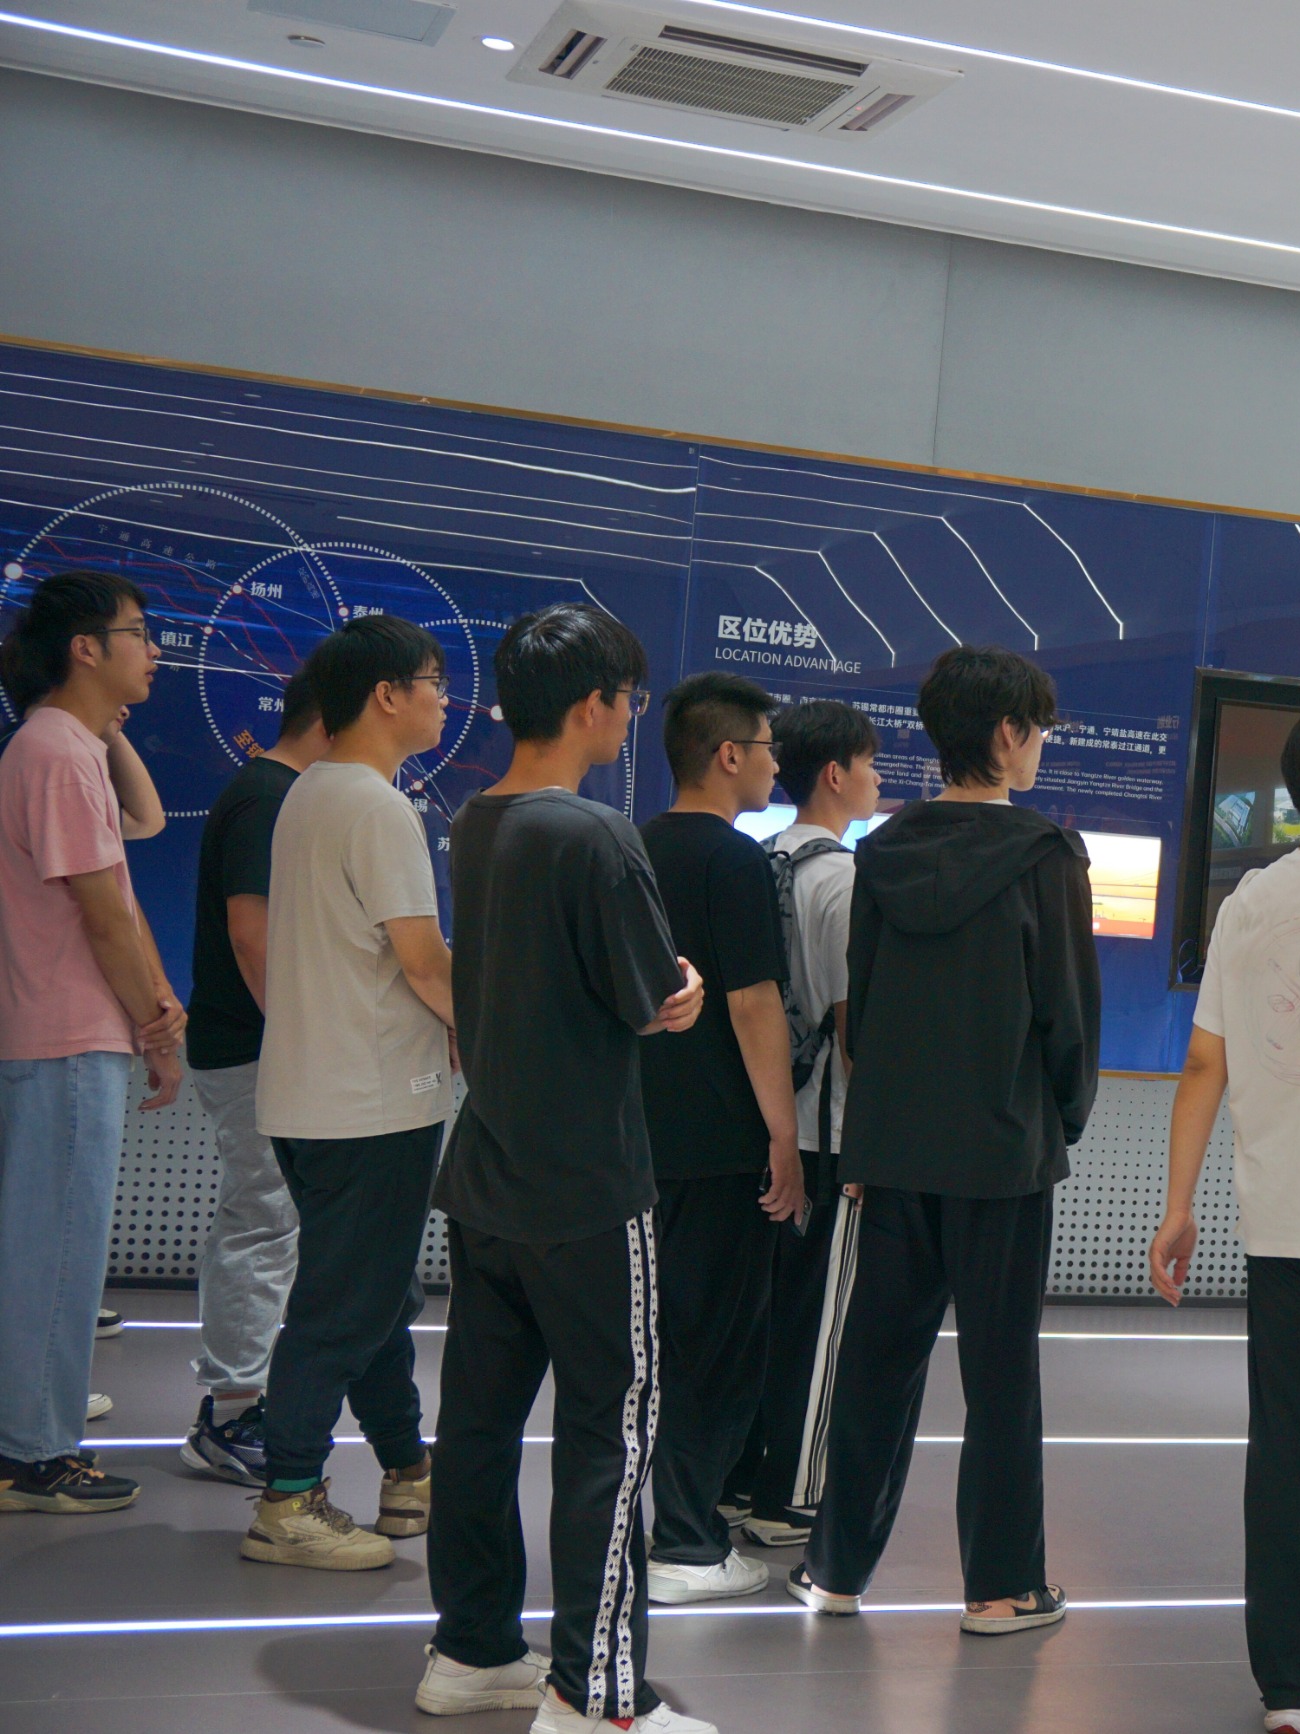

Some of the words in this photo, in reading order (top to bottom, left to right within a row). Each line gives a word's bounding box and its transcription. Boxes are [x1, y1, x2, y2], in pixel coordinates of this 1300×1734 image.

[251, 582, 283, 598] 扬州
[160, 630, 193, 647] 镇江
[718, 615, 818, 649] 区位优势
[715, 648, 781, 665] LOCATION
[784, 655, 862, 674] ADVANTAGE
